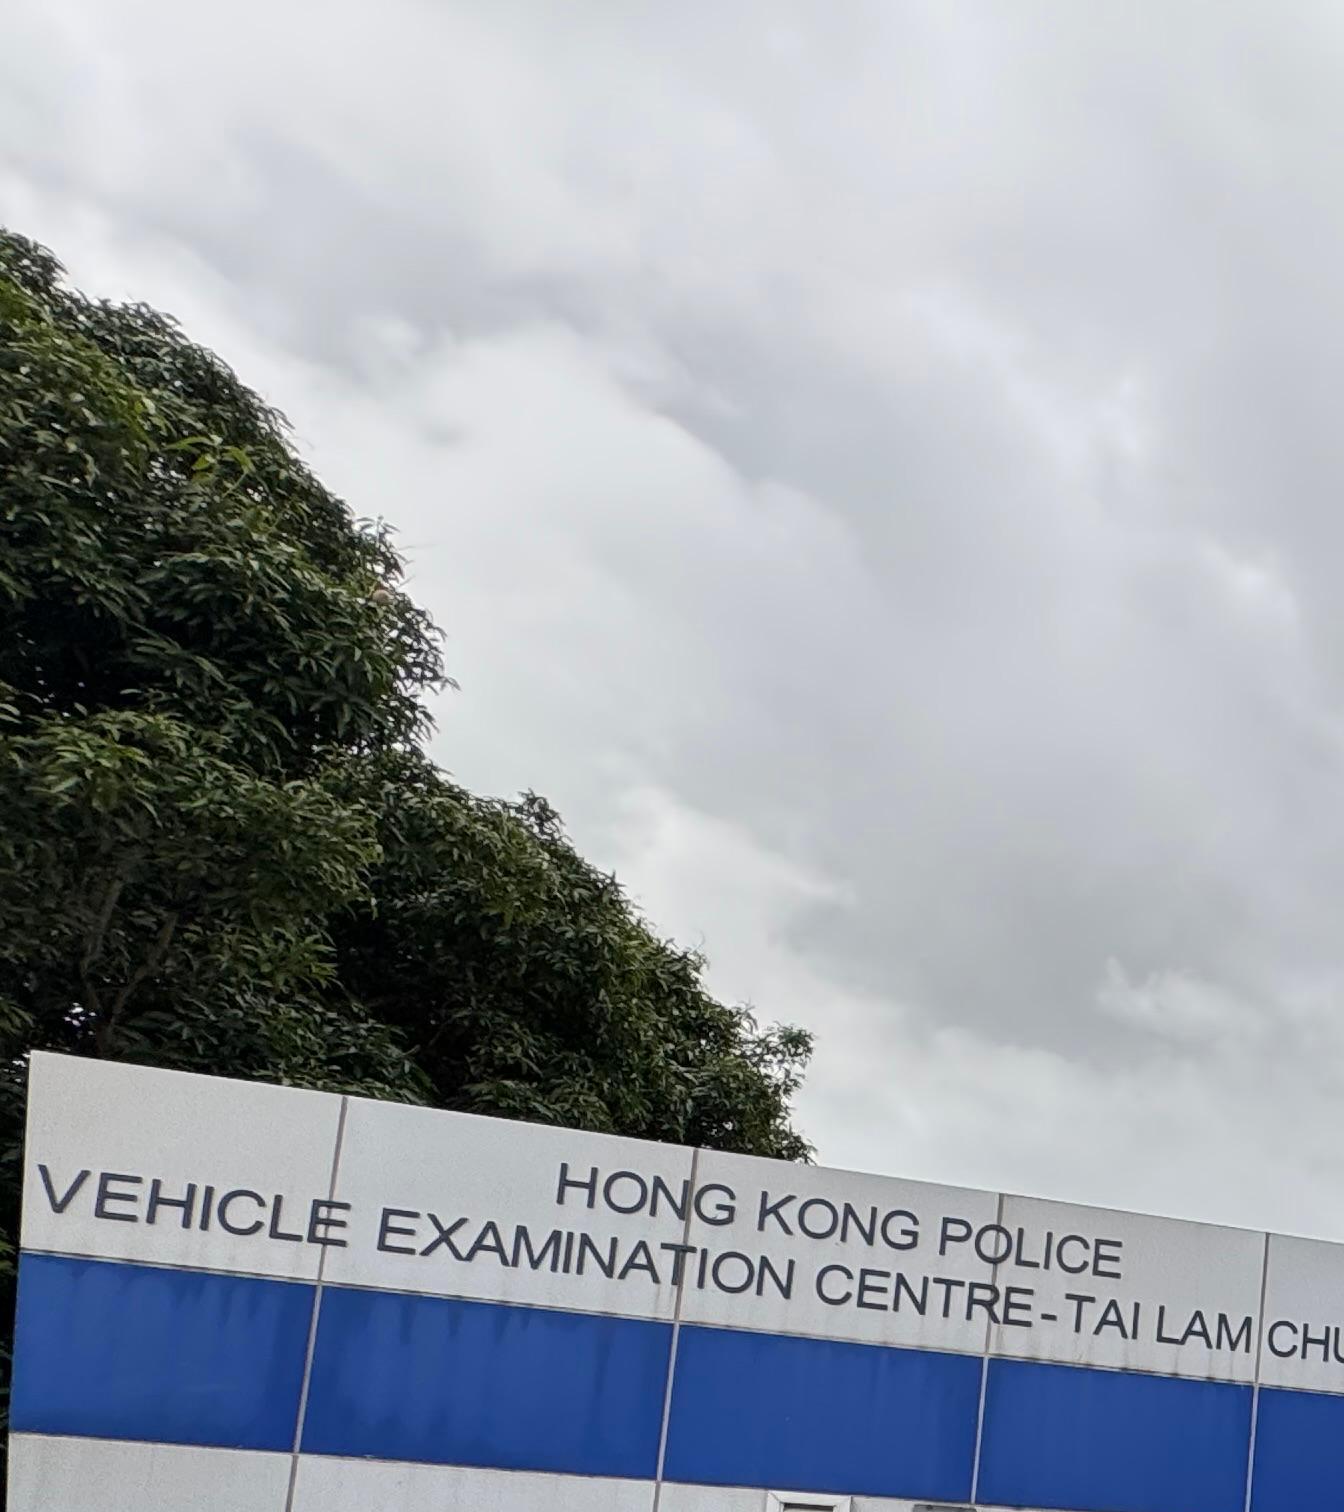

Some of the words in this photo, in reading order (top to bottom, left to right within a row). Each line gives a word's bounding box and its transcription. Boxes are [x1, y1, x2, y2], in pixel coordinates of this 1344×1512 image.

[37, 1164, 351, 1248] VEHICLE
[377, 1208, 794, 1299] EXAMINATION
[1156, 1305, 1253, 1355] LAM
[556, 1162, 735, 1227] HONG
[757, 1189, 919, 1250] KONG
[939, 1217, 1123, 1280] POLICE
